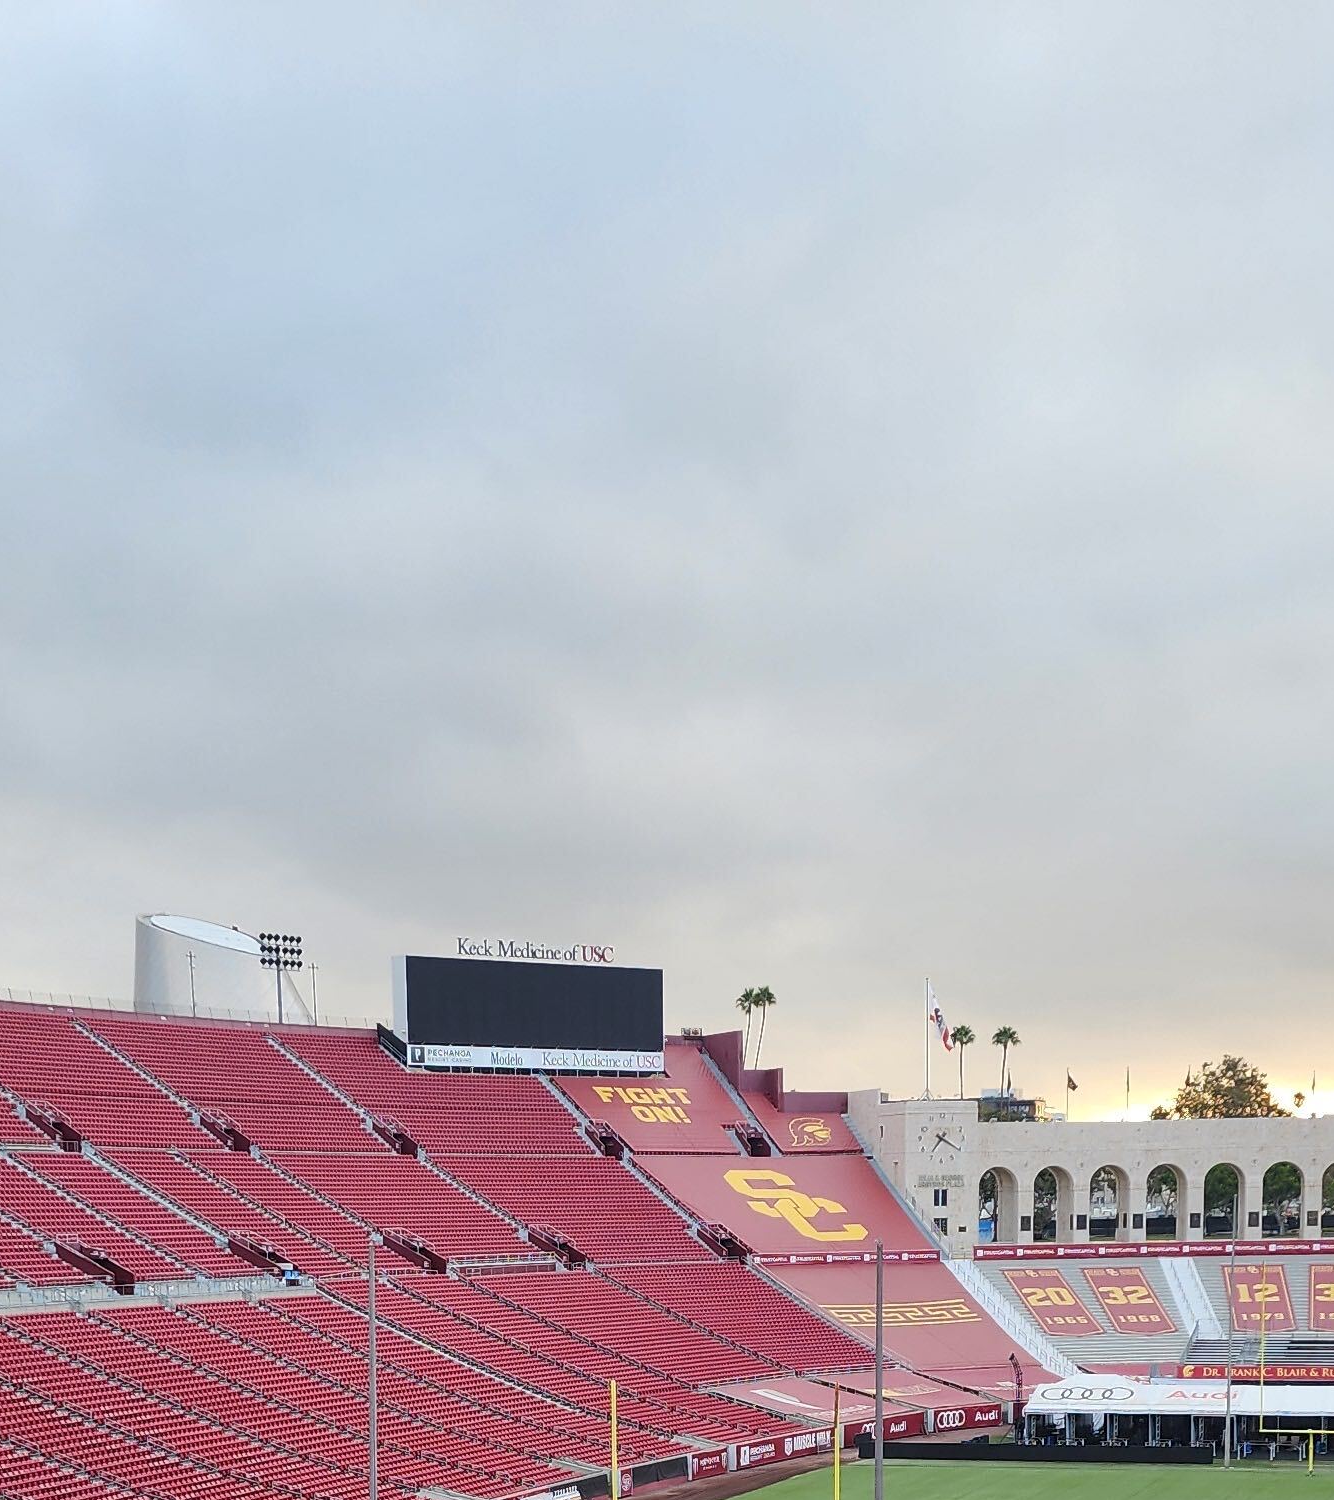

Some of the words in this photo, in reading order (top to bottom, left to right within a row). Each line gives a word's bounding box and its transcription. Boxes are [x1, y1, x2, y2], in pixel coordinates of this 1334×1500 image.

[457, 937, 493, 956] Keck
[497, 939, 562, 961] Medicine
[564, 943, 580, 961] of
[581, 945, 614, 963] USC
[490, 1051, 523, 1066] Modelo
[542, 1051, 568, 1066] Keck
[573, 1053, 620, 1068] Medicine
[622, 1054, 635, 1068] of
[636, 1056, 661, 1069] USC
[592, 1085, 692, 1105] FIGHT
[631, 1105, 692, 1124] ON!
[1021, 1286, 1076, 1307] 20
[1098, 1286, 1154, 1305] 32
[1236, 1283, 1280, 1303] 12
[1119, 1315, 1161, 1323] 1968
[1241, 1312, 1285, 1321] 1979
[1277, 1368, 1307, 1377] BLAIR
[1309, 1369, 1318, 1377] &
[1166, 1389, 1238, 1400] Audi
[974, 1409, 999, 1422] Audi
[890, 1420, 907, 1433] Audi
[794, 1433, 816, 1451] MUSCLE
